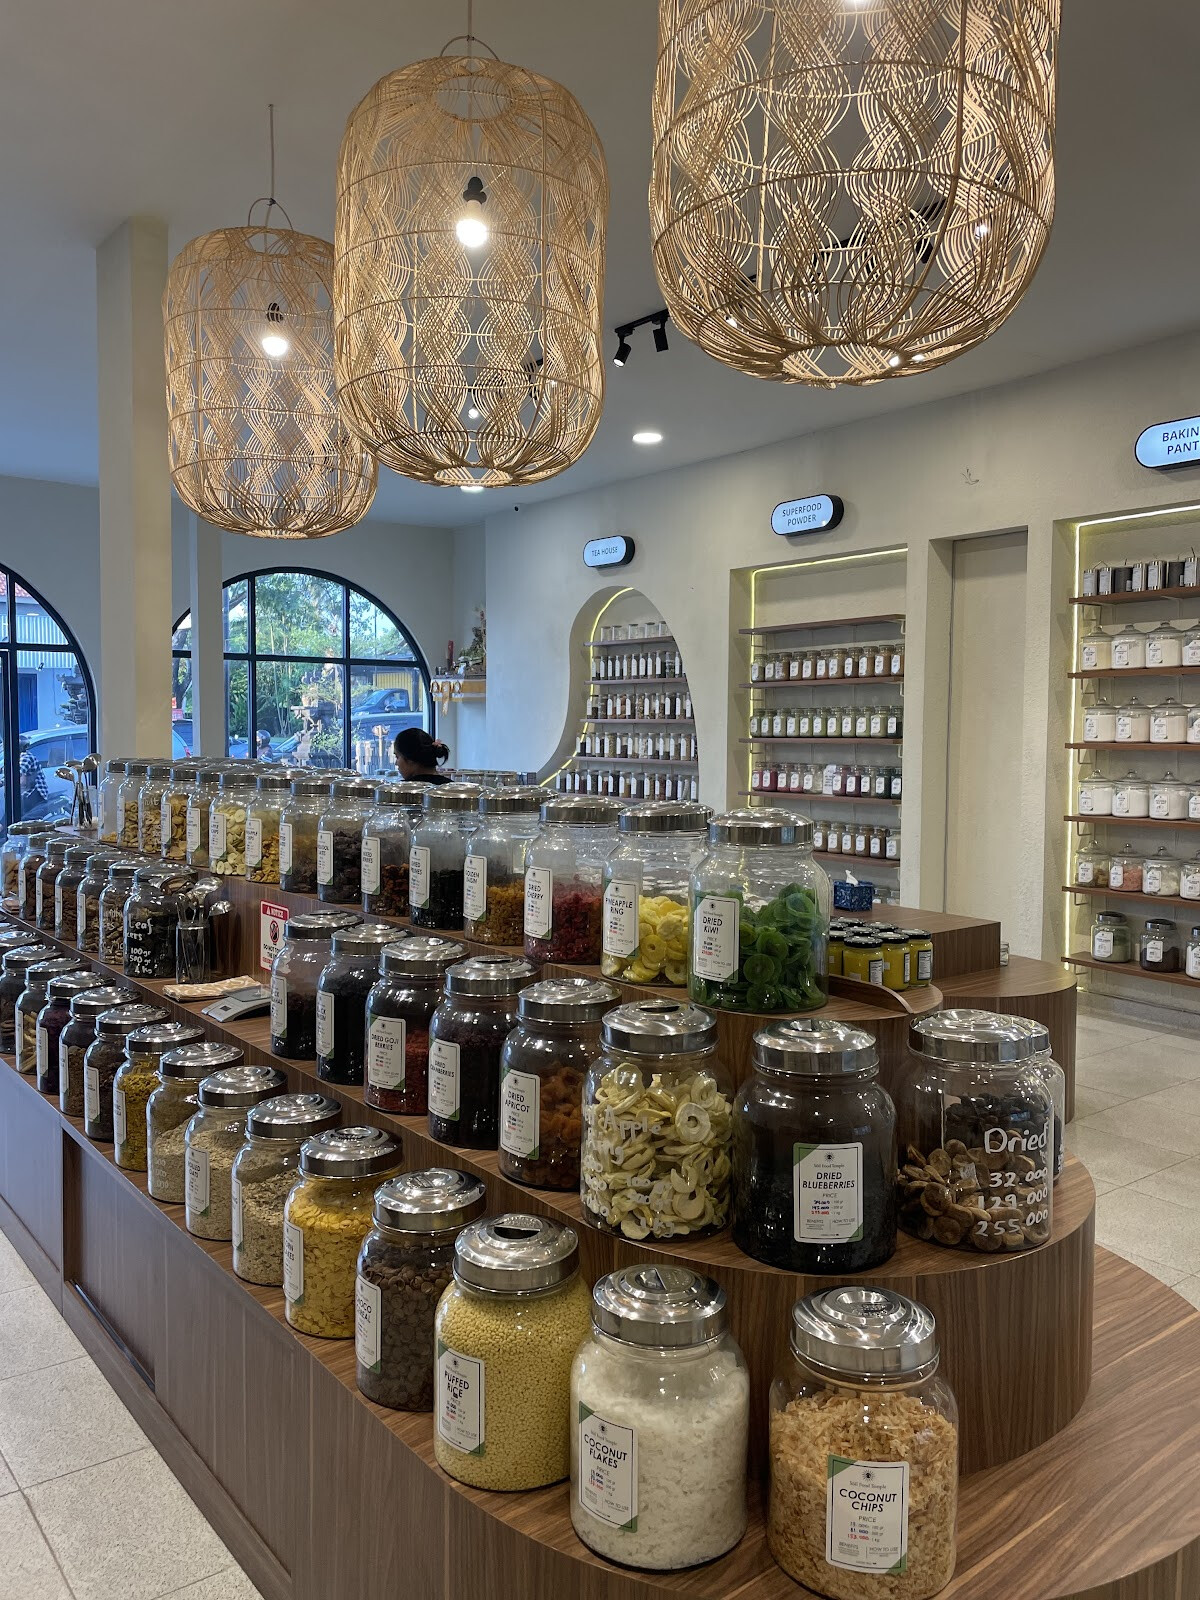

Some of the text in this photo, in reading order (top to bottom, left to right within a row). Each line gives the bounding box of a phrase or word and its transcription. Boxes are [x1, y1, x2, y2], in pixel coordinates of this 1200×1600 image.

[782, 502, 822, 517] SUPERFOOD
[787, 514, 817, 527] POWDER
[601, 546, 618, 556] HOUSE
[528, 884, 542, 892] DRIED
[527, 890, 544, 900] CHERRY
[606, 898, 633, 909] PINEAPPLE
[610, 906, 624, 916] RING
[128, 913, 154, 935] Leaf
[702, 916, 722, 926] DRIED
[704, 925, 719, 934] KIWI
[372, 1034, 384, 1042] DRIED
[374, 1042, 393, 1051] BERRIES
[434, 1060, 446, 1068] DRIED
[430, 1064, 454, 1078] CRANBERRIES
[508, 1090, 525, 1102] DRIED
[505, 1100, 530, 1113] APRICOT
[984, 1120, 1050, 1154] Dried
[189, 1169, 199, 1178] OATS
[816, 1172, 842, 1180] DRIED
[988, 1166, 1048, 1188] 32.000
[802, 1180, 855, 1190] BLUEBERRIES
[978, 1186, 1048, 1210] 129.000
[444, 1370, 470, 1390] PUFFED
[447, 1382, 463, 1398] RICE
[584, 1434, 627, 1460] COCONUT
[590, 1448, 618, 1469] FLAKES
[840, 1488, 898, 1502] COCONUT
[851, 1501, 883, 1512] CHIPS
